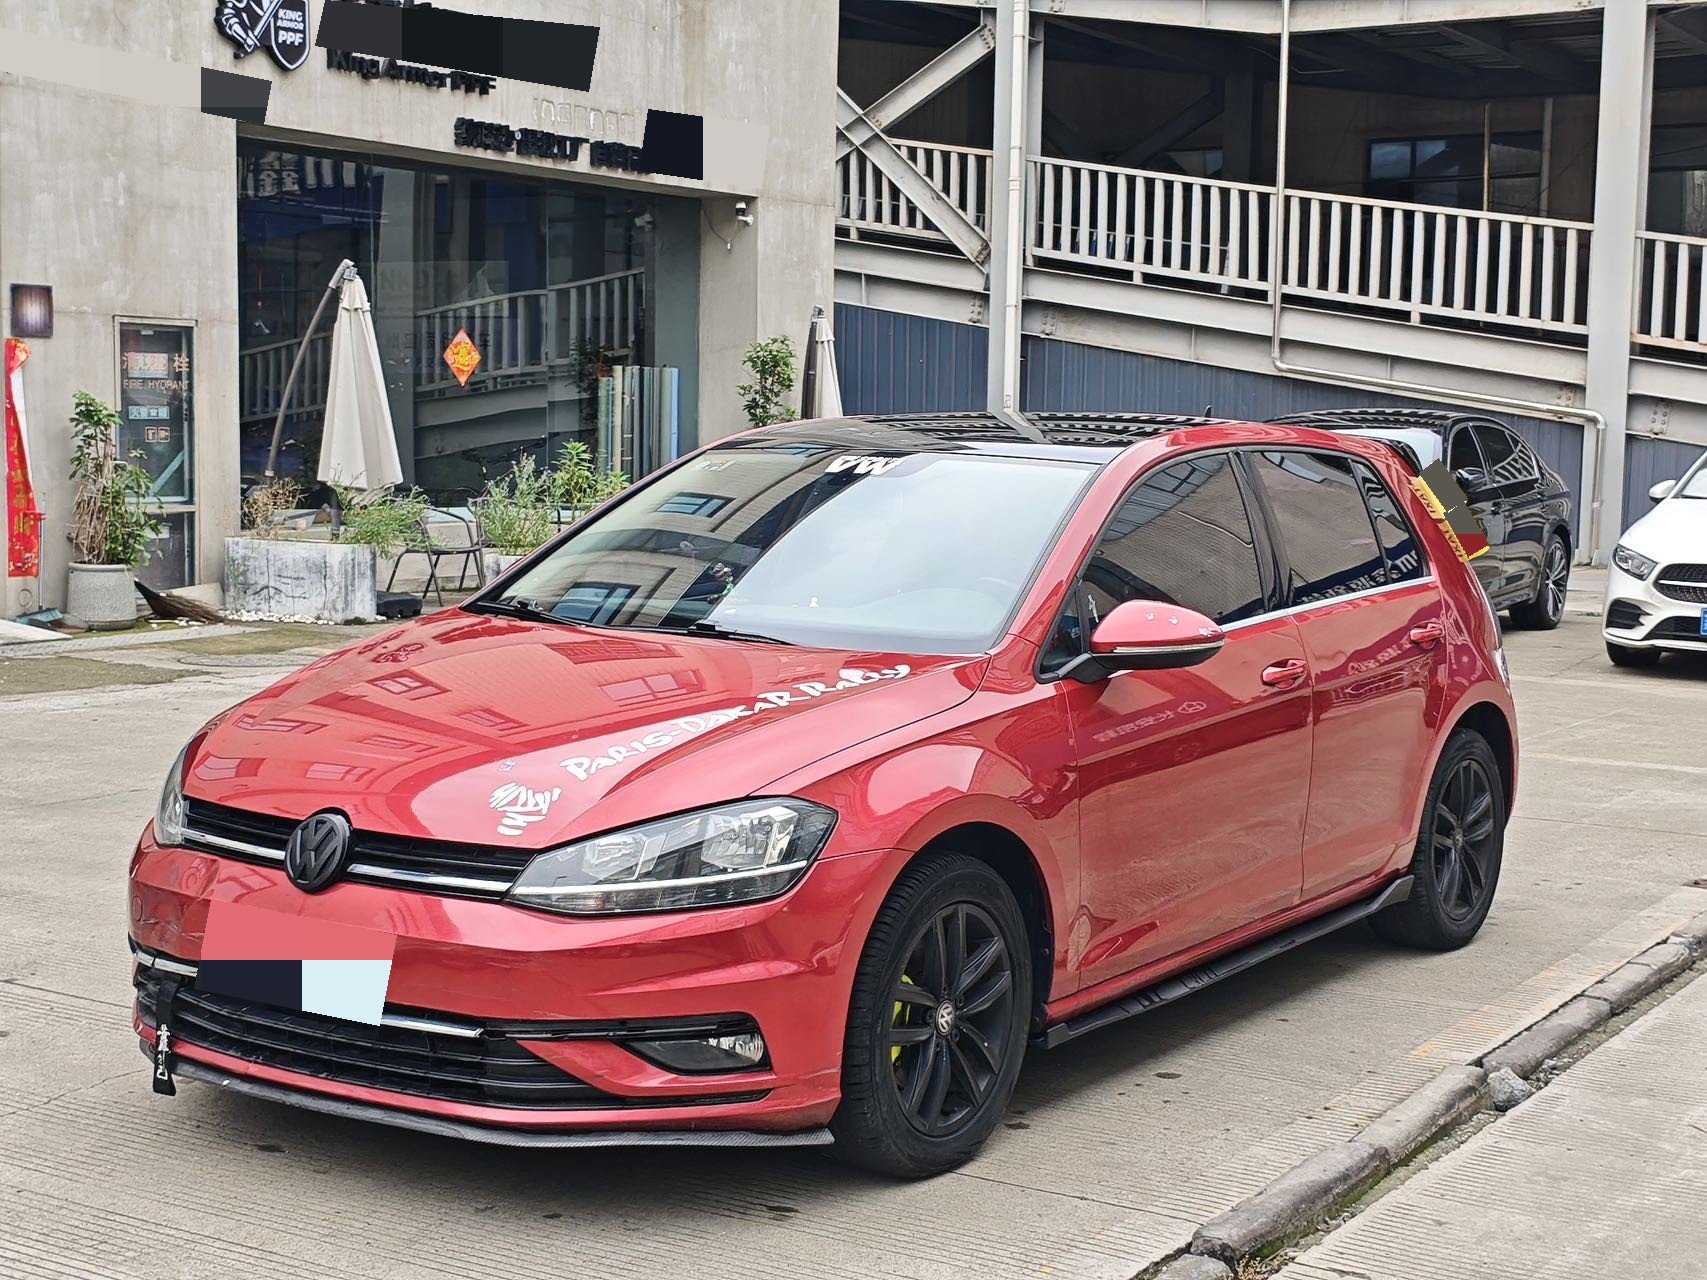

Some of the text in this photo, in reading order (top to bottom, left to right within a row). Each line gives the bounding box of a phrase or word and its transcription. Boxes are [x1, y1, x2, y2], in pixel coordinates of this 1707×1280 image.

[278, 9, 303, 21] KING
[277, 19, 304, 30] ARMOR
[278, 30, 304, 46] PPF
[327, 49, 380, 80] King
[451, 70, 497, 95] PPF
[123, 379, 190, 392] FIRE HYDRANT
